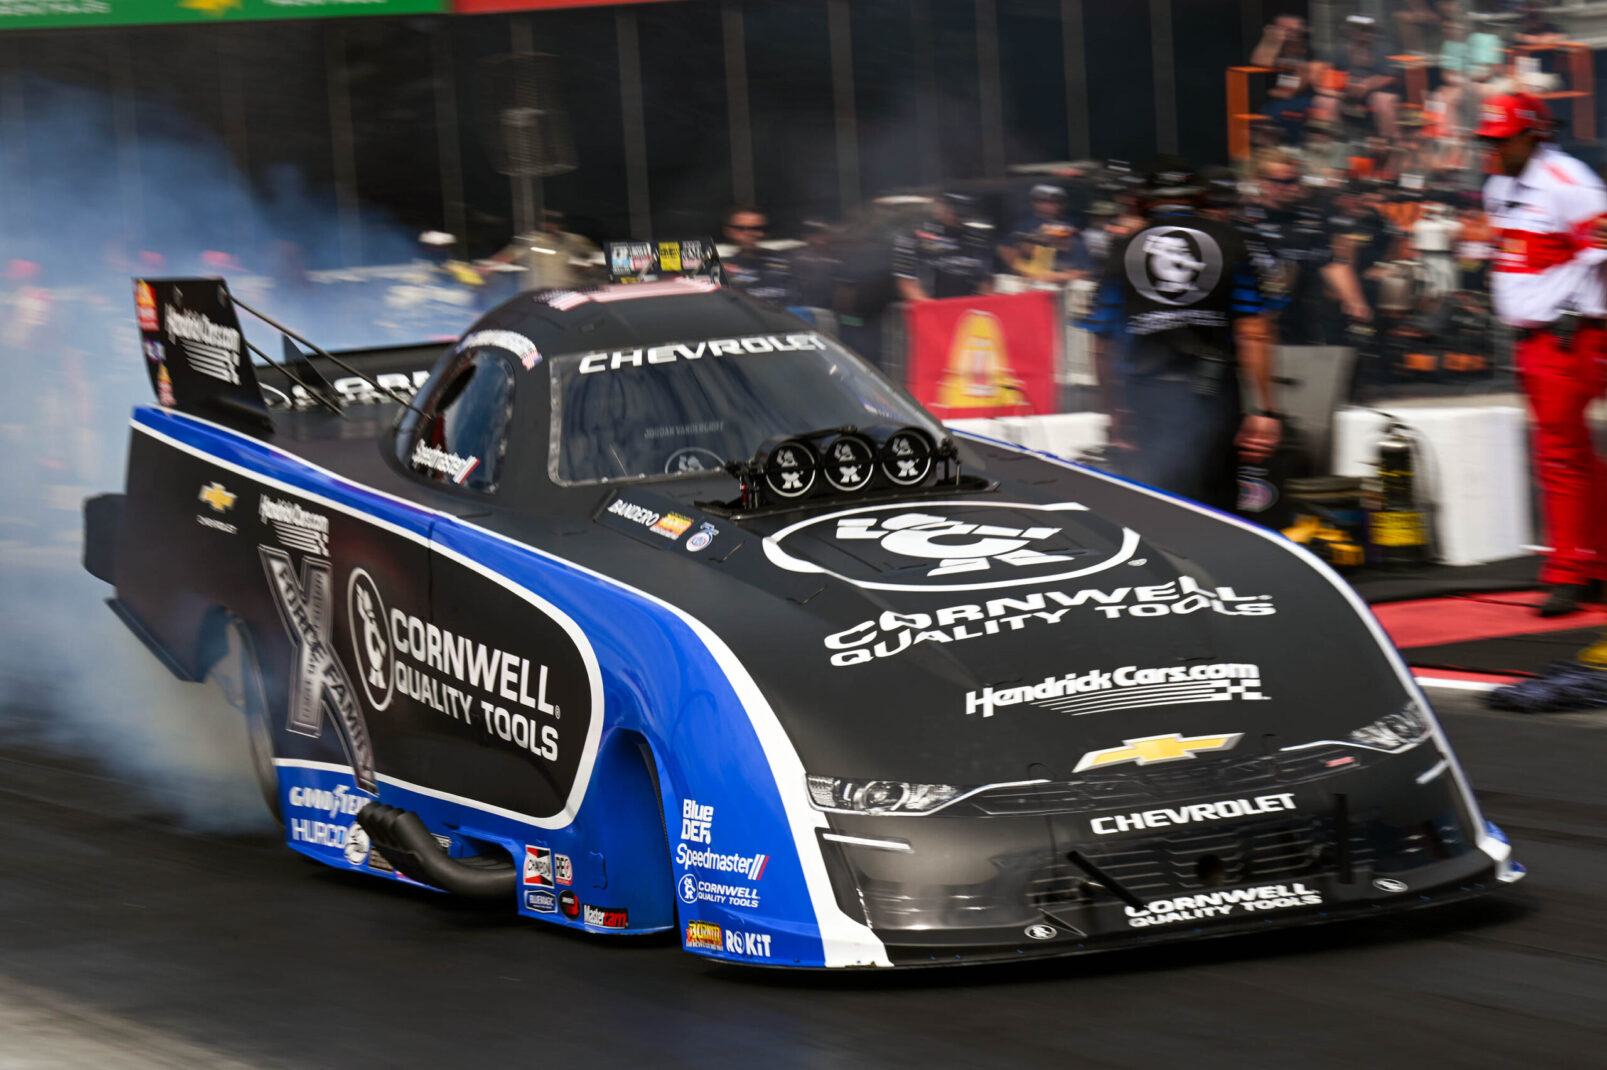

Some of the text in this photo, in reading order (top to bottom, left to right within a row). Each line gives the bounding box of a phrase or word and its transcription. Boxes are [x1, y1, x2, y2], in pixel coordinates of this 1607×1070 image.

[578, 335, 826, 375] CHEVROLET
[608, 499, 660, 527] BANDERO
[823, 575, 1260, 650] CORNWELL
[830, 594, 1276, 667] QUALITY TOOLS
[391, 607, 555, 716] CORNWELL
[966, 663, 1260, 718] HendrickCars.com
[395, 660, 559, 762] QUALITY TOOLS
[683, 799, 714, 822] Blue
[1090, 793, 1297, 835] CHEVROLET
[681, 819, 712, 844] DEF
[676, 843, 755, 875] Speedmaster
[698, 881, 760, 899] CORNWELL
[698, 892, 760, 908] QUALITY TOOLS
[1128, 894, 1323, 928] QUALITY TOOLS
